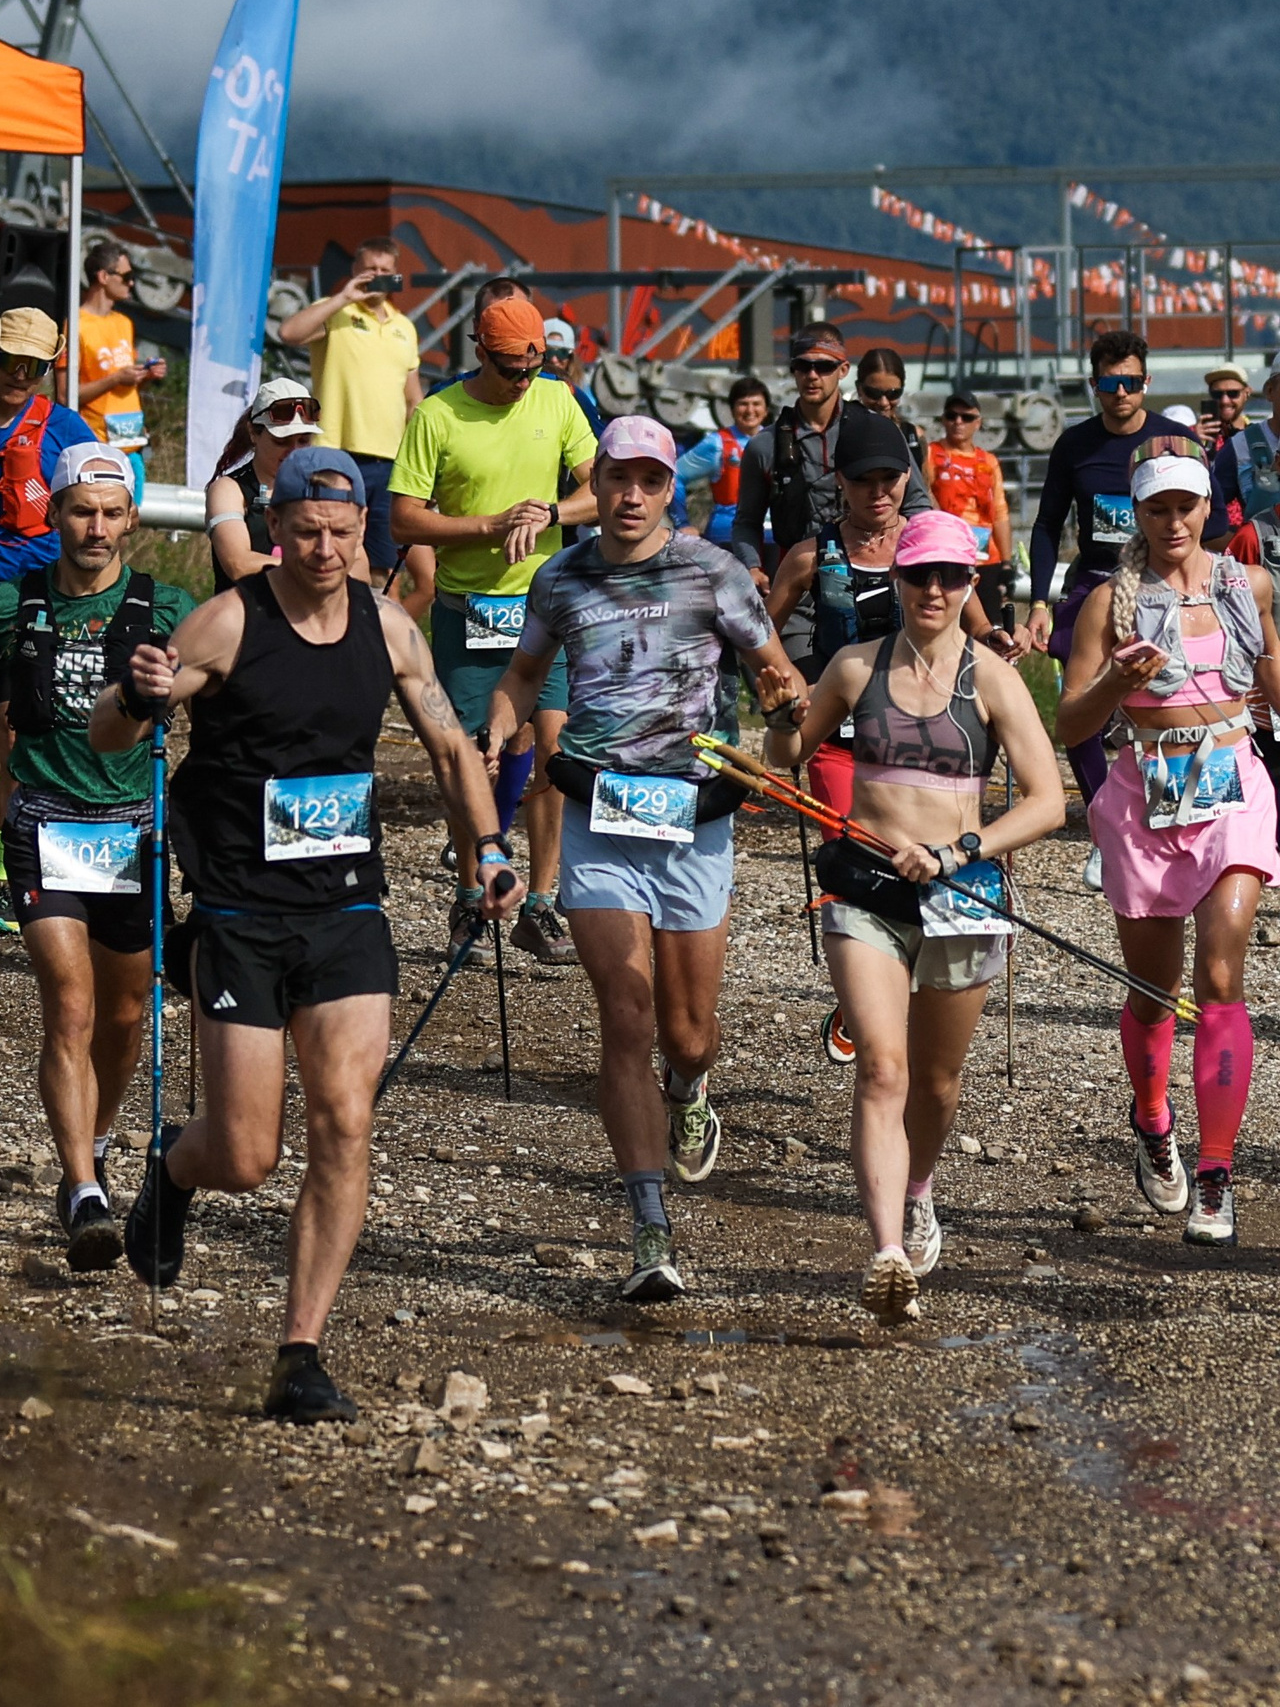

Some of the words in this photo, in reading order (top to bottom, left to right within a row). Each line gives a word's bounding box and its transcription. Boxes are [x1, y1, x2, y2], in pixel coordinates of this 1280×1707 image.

[484, 606, 524, 630] 126
[853, 737, 984, 776] didas
[617, 783, 669, 815] 129
[1167, 770, 1213, 802] 11
[288, 797, 341, 831] 123
[62, 839, 113, 869] 104
